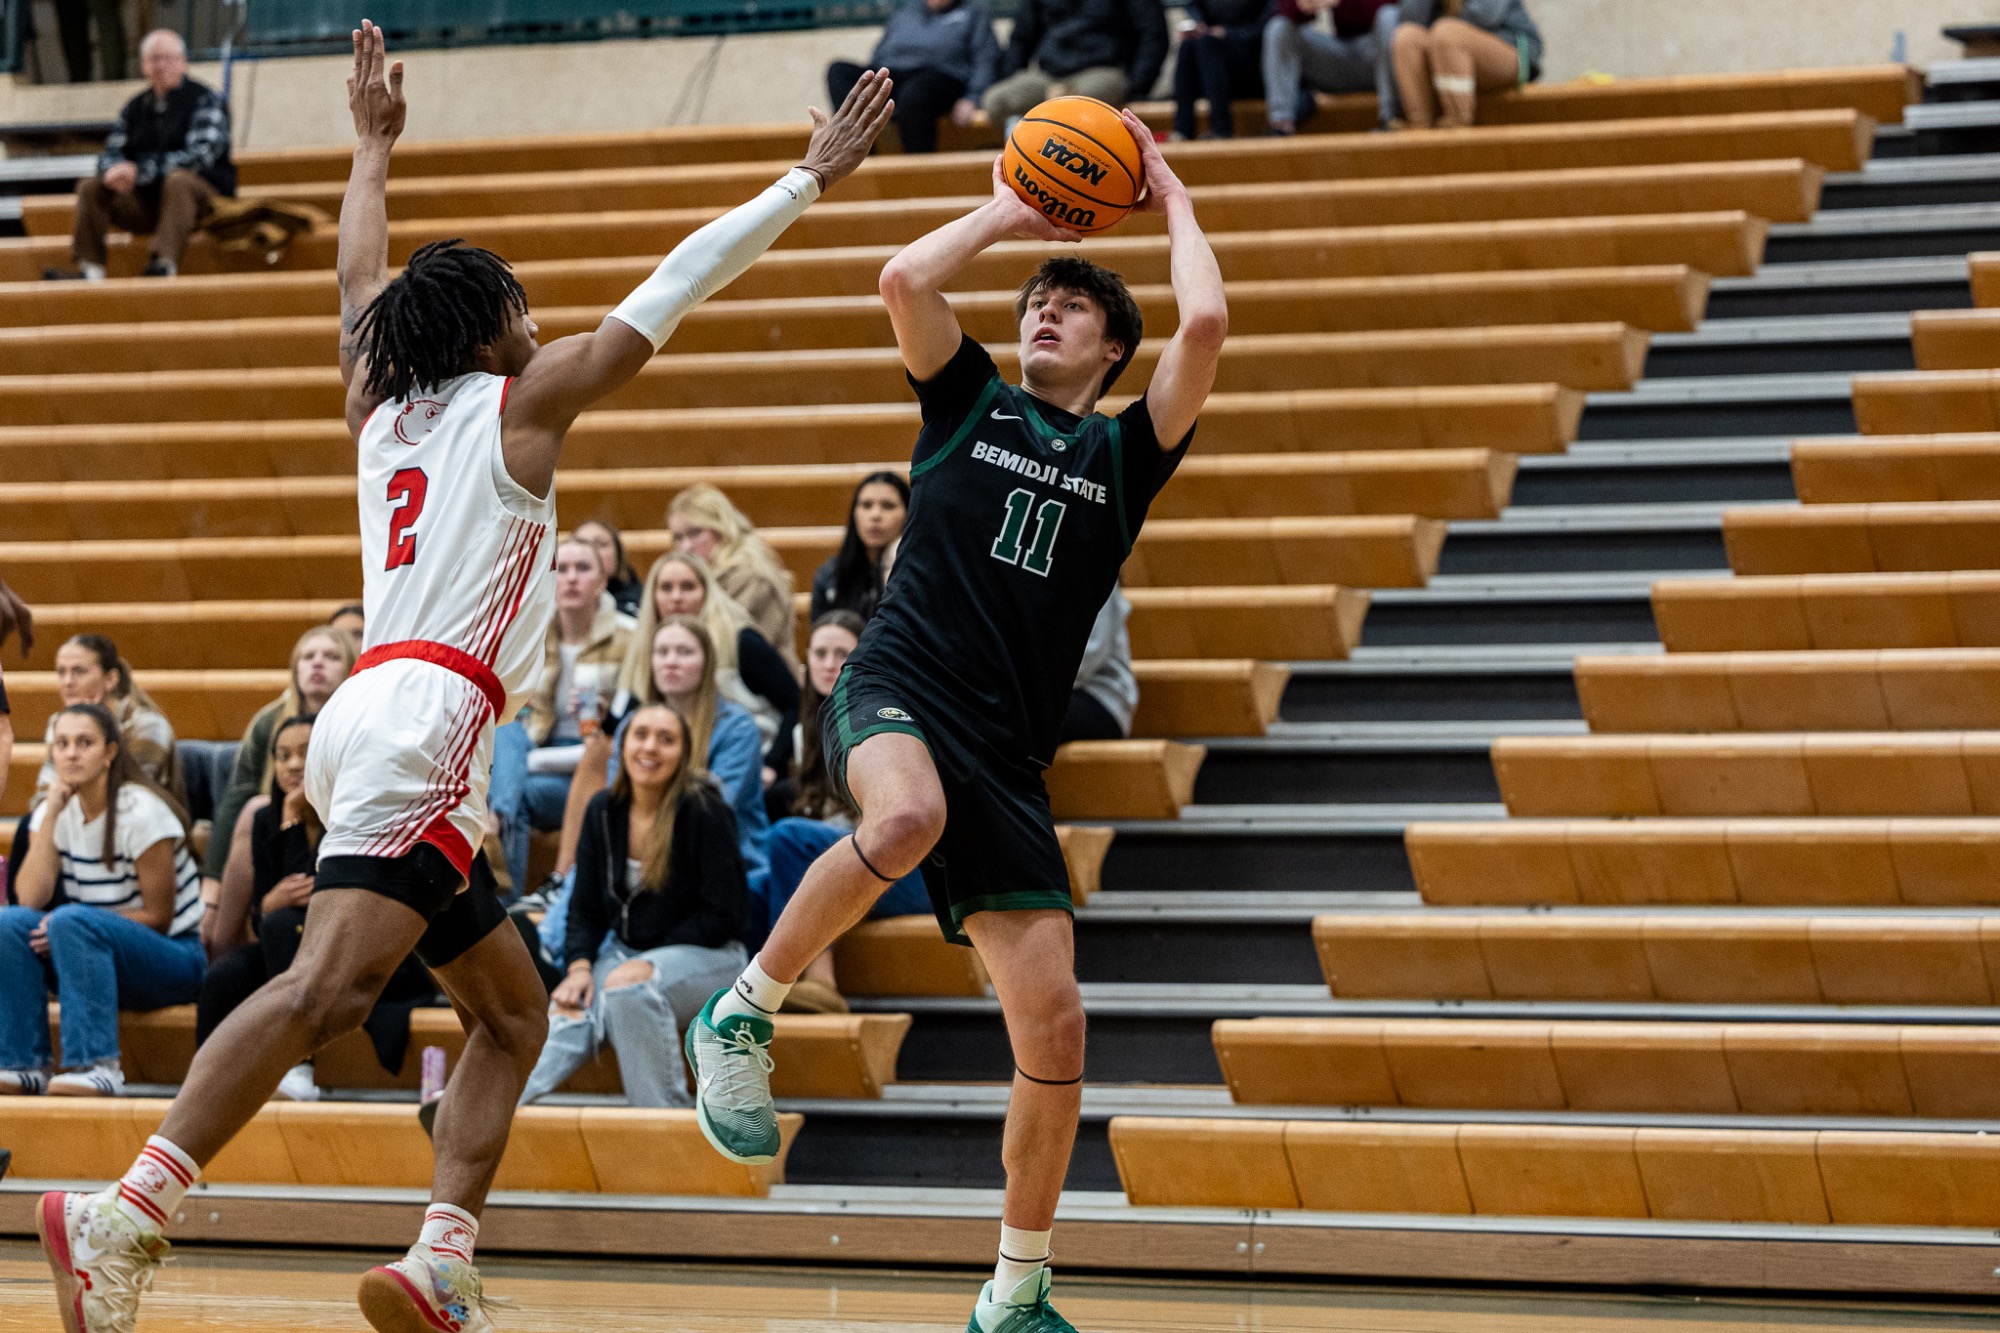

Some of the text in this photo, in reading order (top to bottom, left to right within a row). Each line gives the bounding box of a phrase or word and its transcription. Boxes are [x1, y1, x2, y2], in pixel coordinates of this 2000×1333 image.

[1040, 136, 1109, 187] NCAA
[1014, 163, 1096, 227] Wilson
[971, 440, 1107, 504] BEMIDJI STATE
[384, 466, 429, 572] 2
[990, 487, 1067, 578] 11
